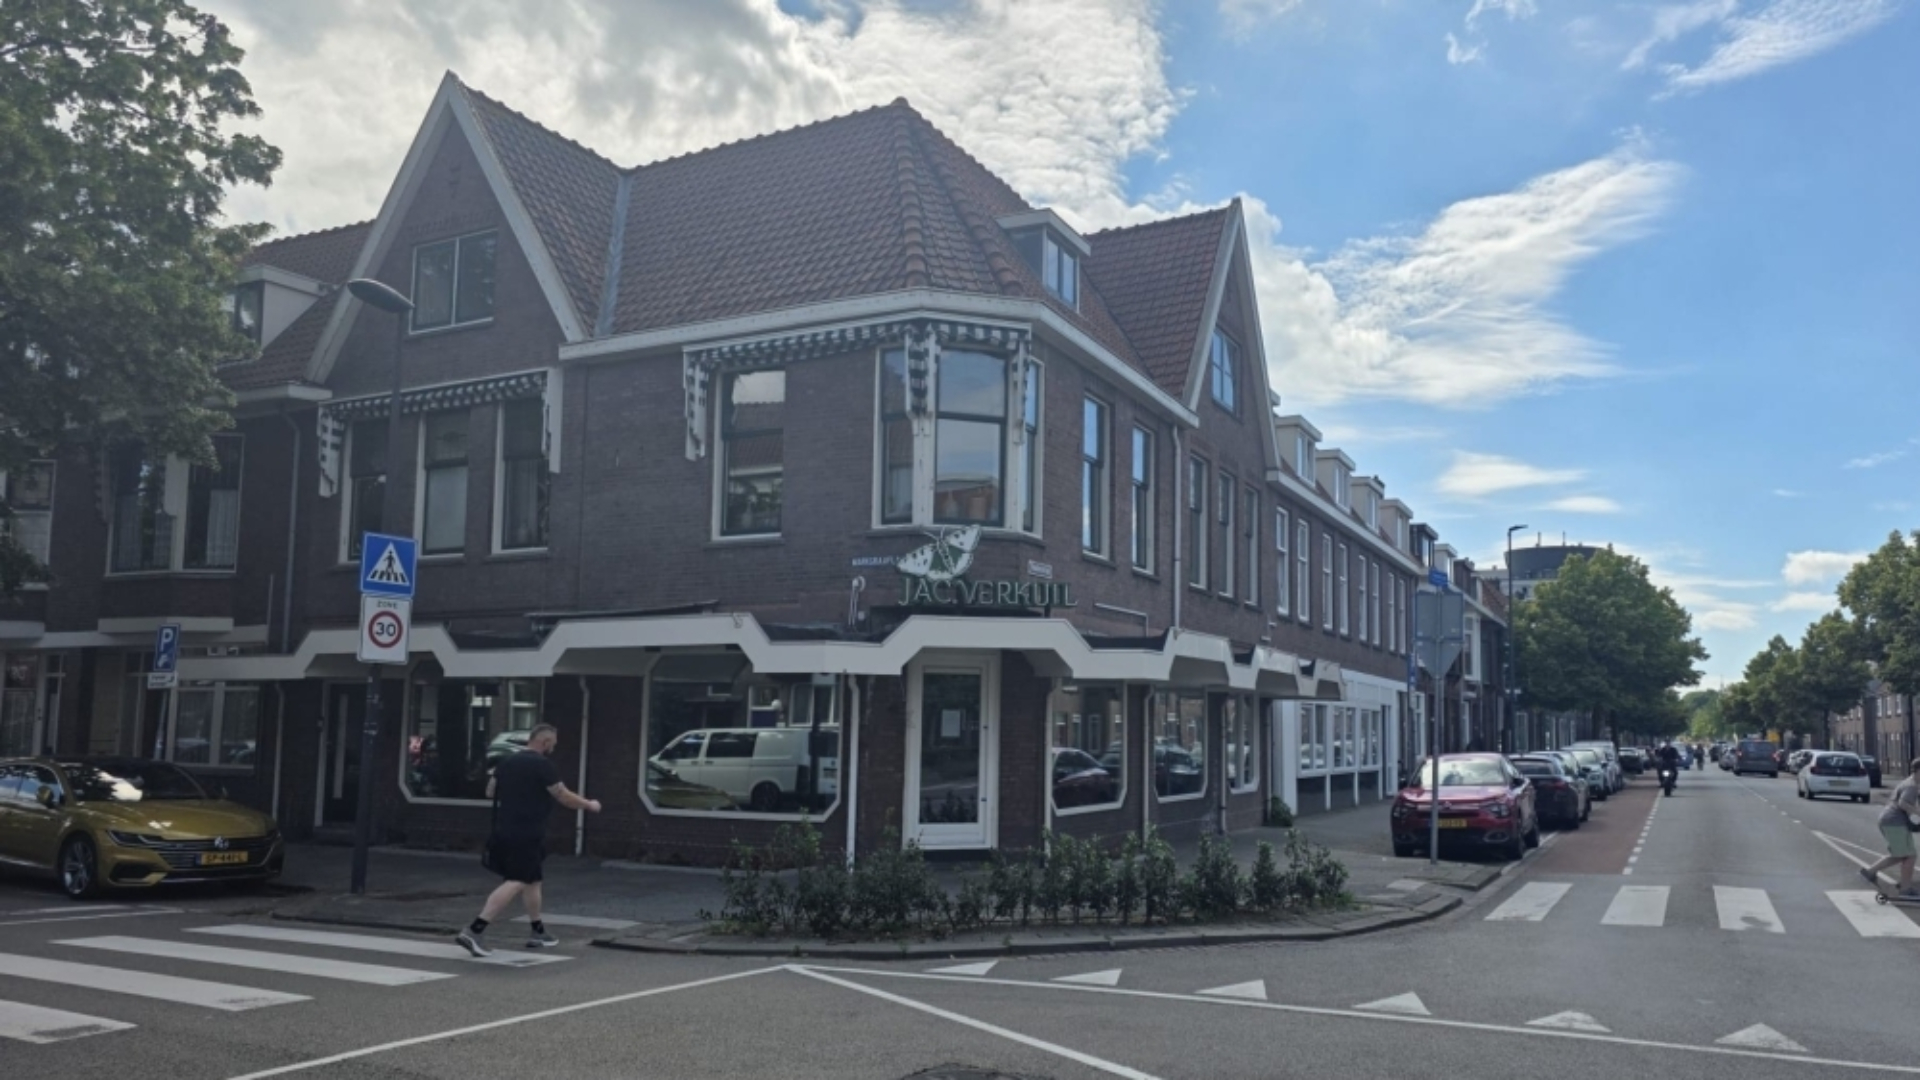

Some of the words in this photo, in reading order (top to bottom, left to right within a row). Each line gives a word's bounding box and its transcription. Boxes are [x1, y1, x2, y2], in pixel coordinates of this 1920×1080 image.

[956, 579, 1079, 607] VERKUIL
[376, 600, 399, 610] ZONE
[374, 622, 397, 637] 30
[160, 627, 174, 653] P
